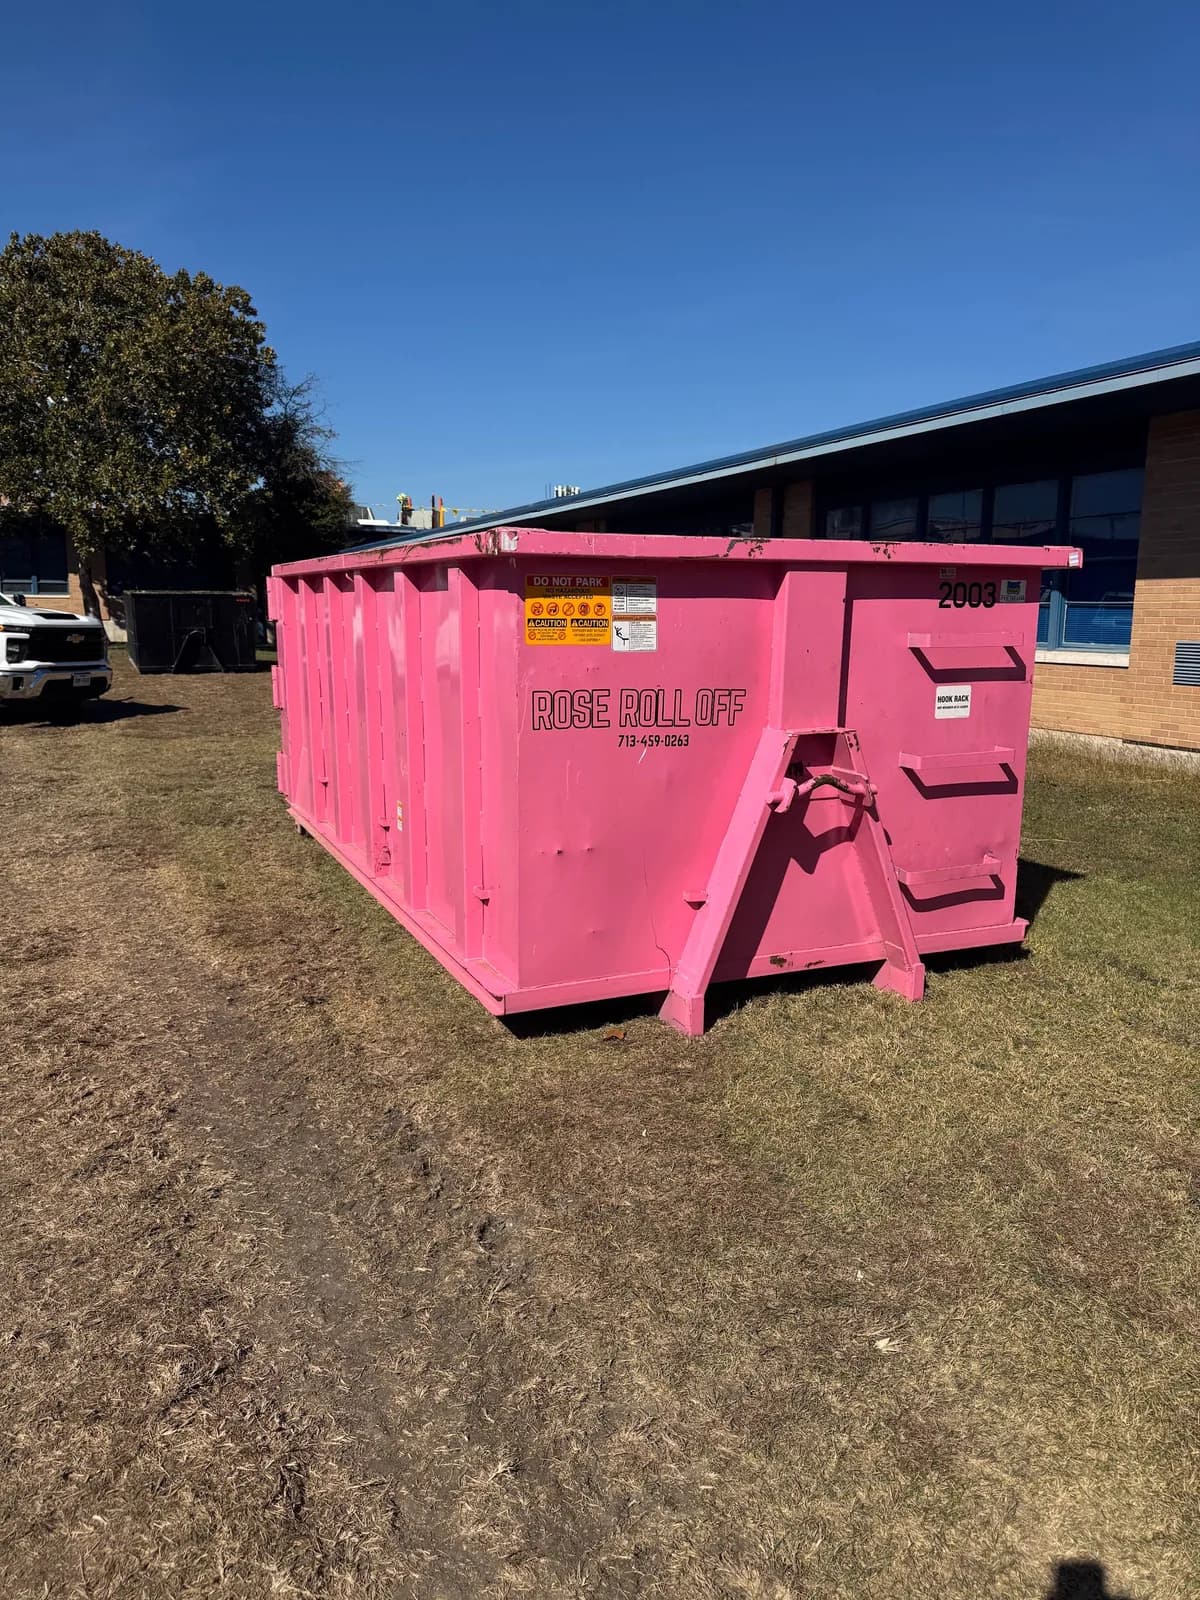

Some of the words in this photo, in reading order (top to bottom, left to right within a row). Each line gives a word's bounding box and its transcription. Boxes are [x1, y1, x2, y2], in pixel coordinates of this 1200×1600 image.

[533, 577, 548, 586] DO
[552, 577, 572, 586] NOT
[575, 577, 603, 587] PARK
[938, 581, 996, 608] 2003
[535, 619, 567, 627] CAUTION
[578, 619, 609, 628] CAUTION
[937, 695, 953, 703] HOOK
[954, 694, 969, 703] RACK
[532, 689, 610, 730] ROSE
[619, 688, 690, 728] ROLL
[695, 688, 747, 727] OFF
[618, 735, 690, 748] 713-459-0263
